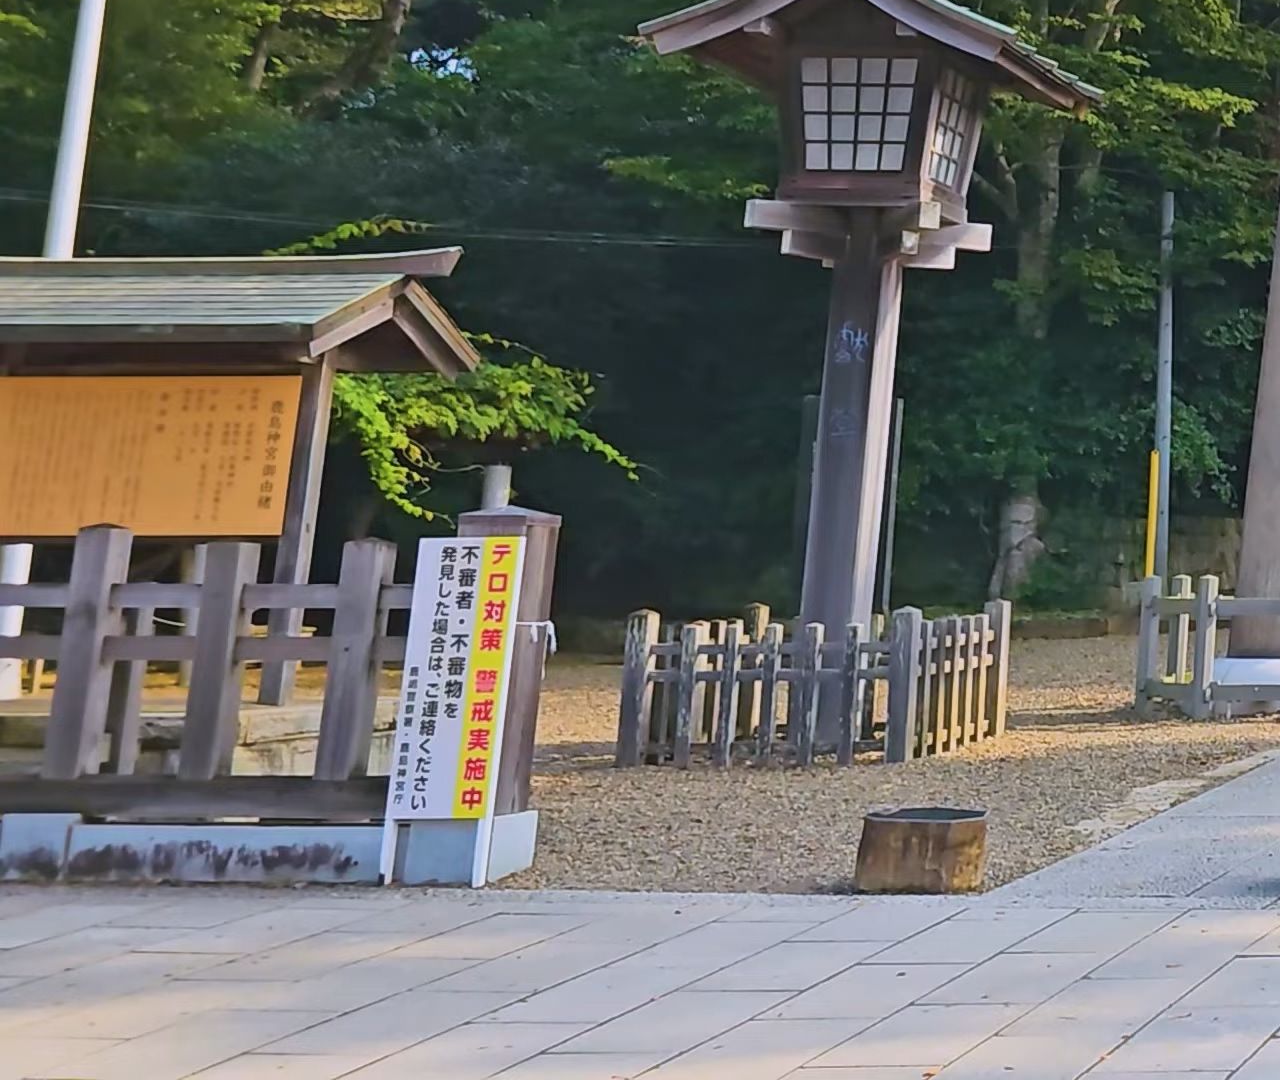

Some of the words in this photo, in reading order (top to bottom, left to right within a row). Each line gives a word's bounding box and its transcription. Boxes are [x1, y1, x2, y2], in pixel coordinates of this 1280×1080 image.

[444, 546, 480, 718] 不審者・不審物を
[480, 544, 512, 652] テロ対策
[411, 546, 457, 810] 発見した場合は、ご連絡ください
[461, 670, 498, 810] 警戒実施中
